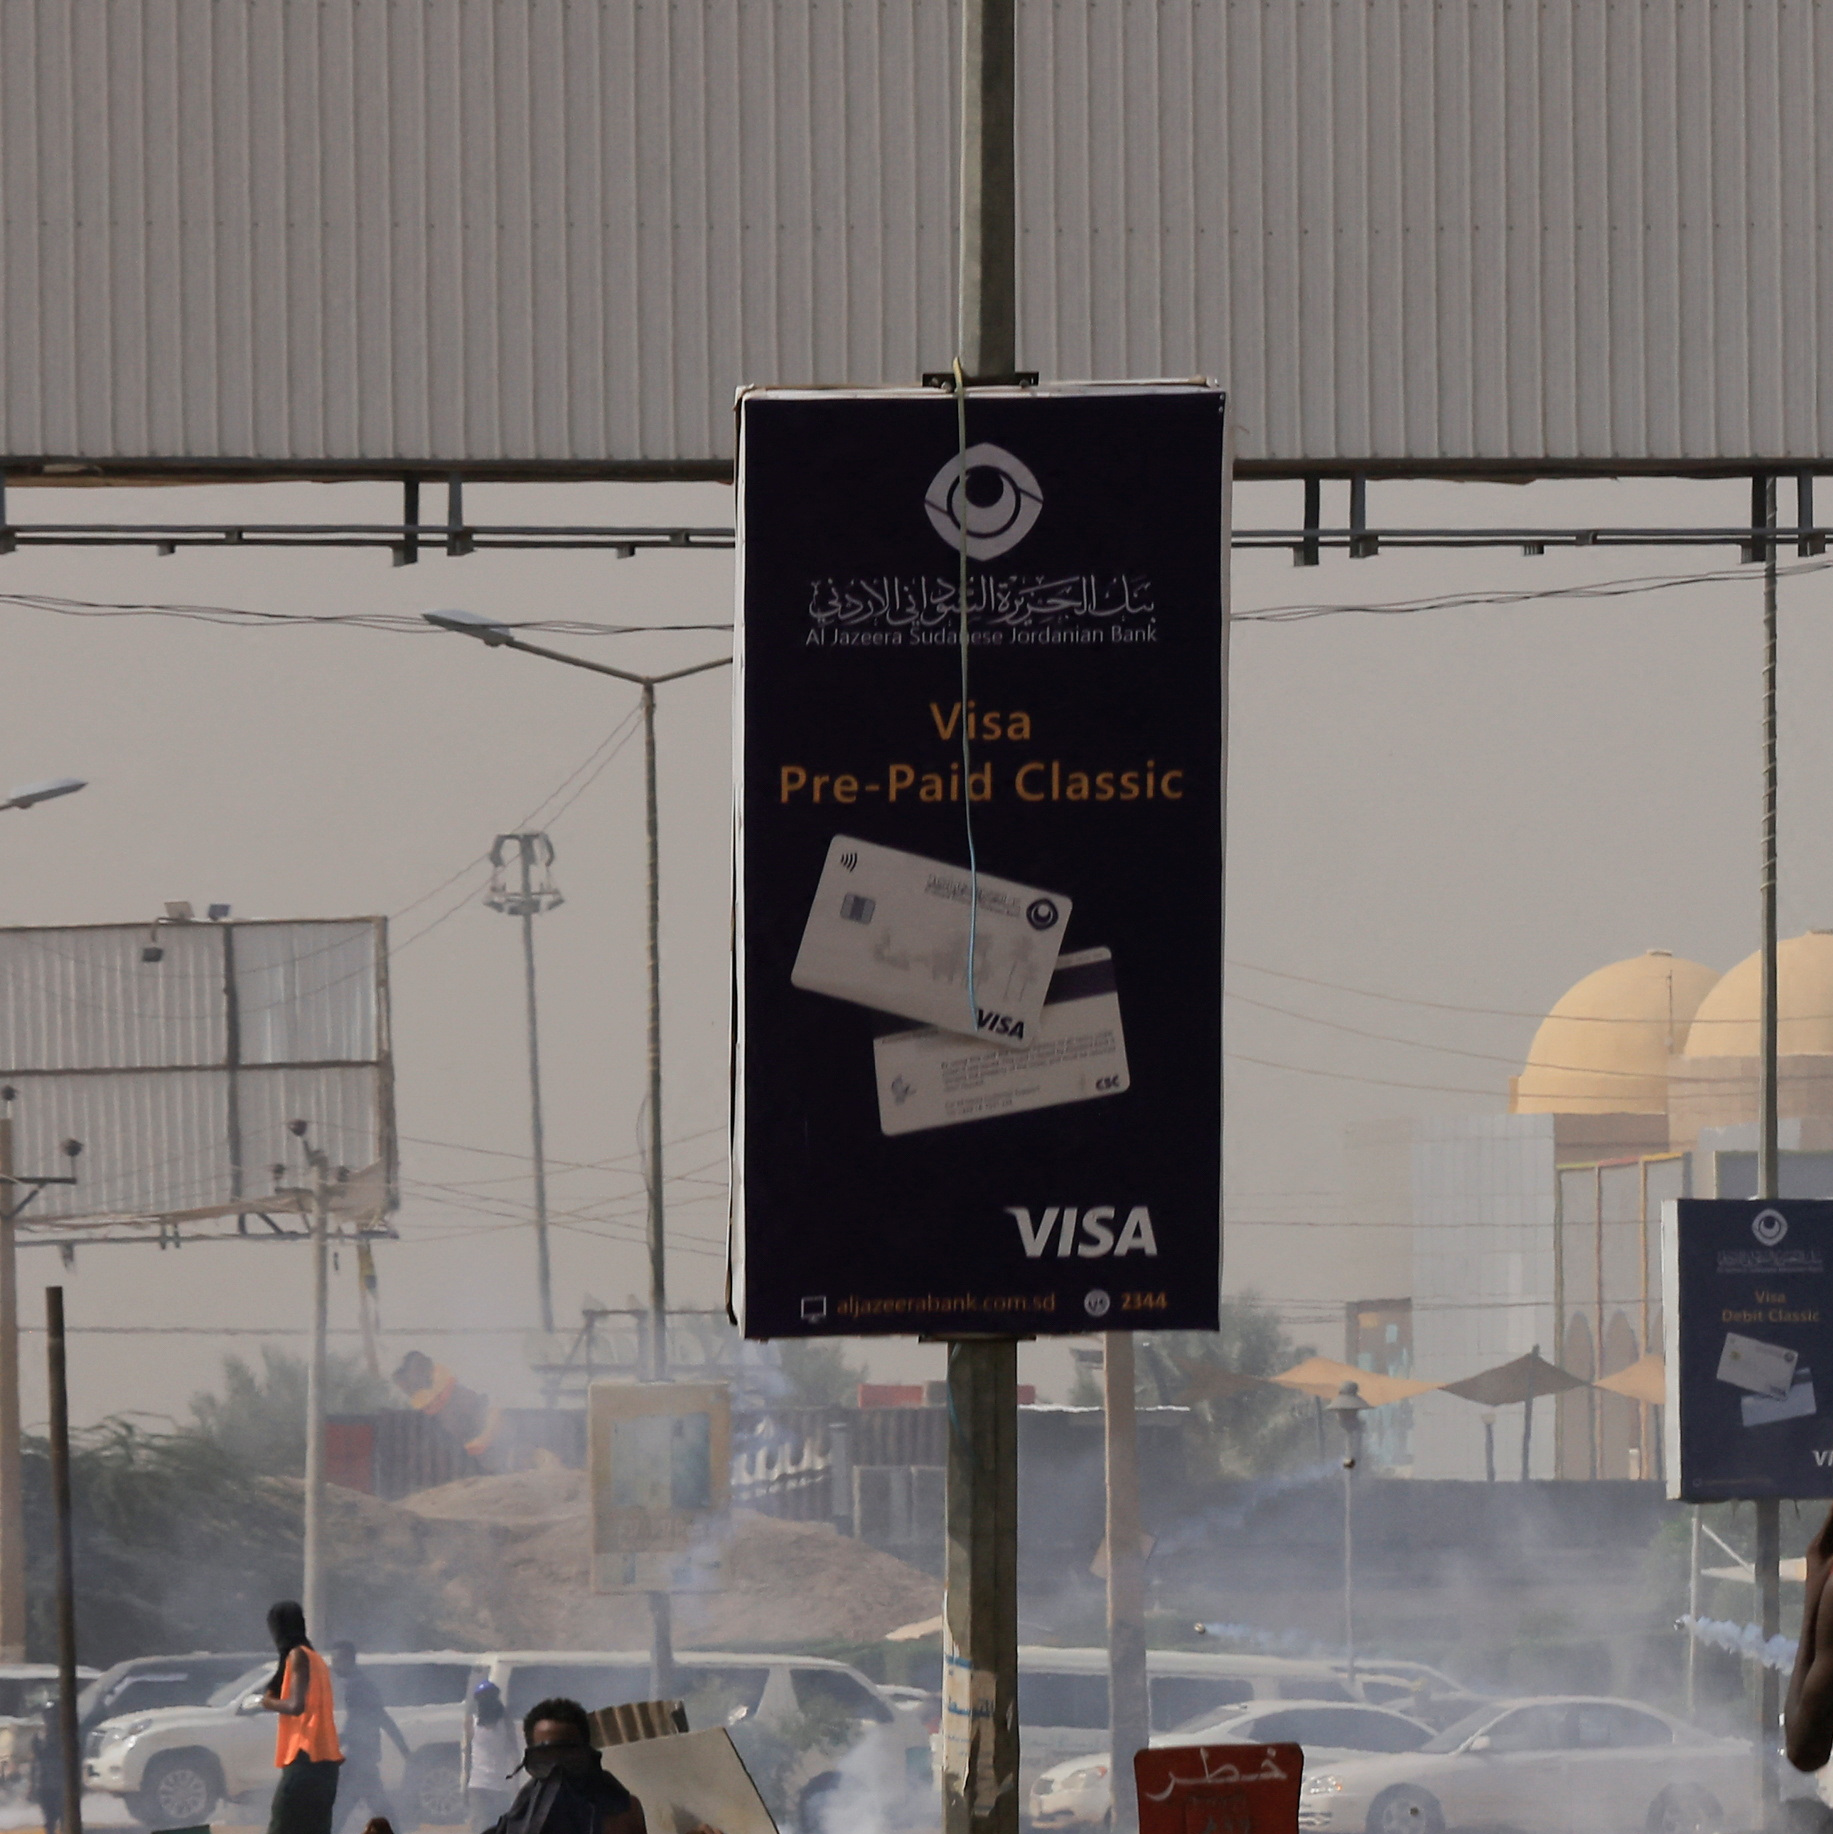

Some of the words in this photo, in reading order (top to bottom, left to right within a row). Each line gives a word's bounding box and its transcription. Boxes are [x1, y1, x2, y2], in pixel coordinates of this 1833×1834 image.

[805, 628, 825, 646] Al
[830, 627, 902, 646] Jazeera
[1009, 624, 1104, 645] Jordanian
[1111, 623, 1158, 643] Bank
[929, 700, 1032, 741] Visa
[780, 762, 992, 804] Pre-Paid
[1014, 760, 1184, 802] Classic
[977, 1008, 1025, 1041] VISA
[1004, 1206, 1158, 1259] VISA
[837, 1292, 1056, 1318] aljazeerabank.com.sd
[1755, 1290, 1787, 1304] Visa
[1722, 1308, 1763, 1322] Debit
[1768, 1308, 1820, 1323] Classic
[1146, 1747, 1288, 1801] خطر
